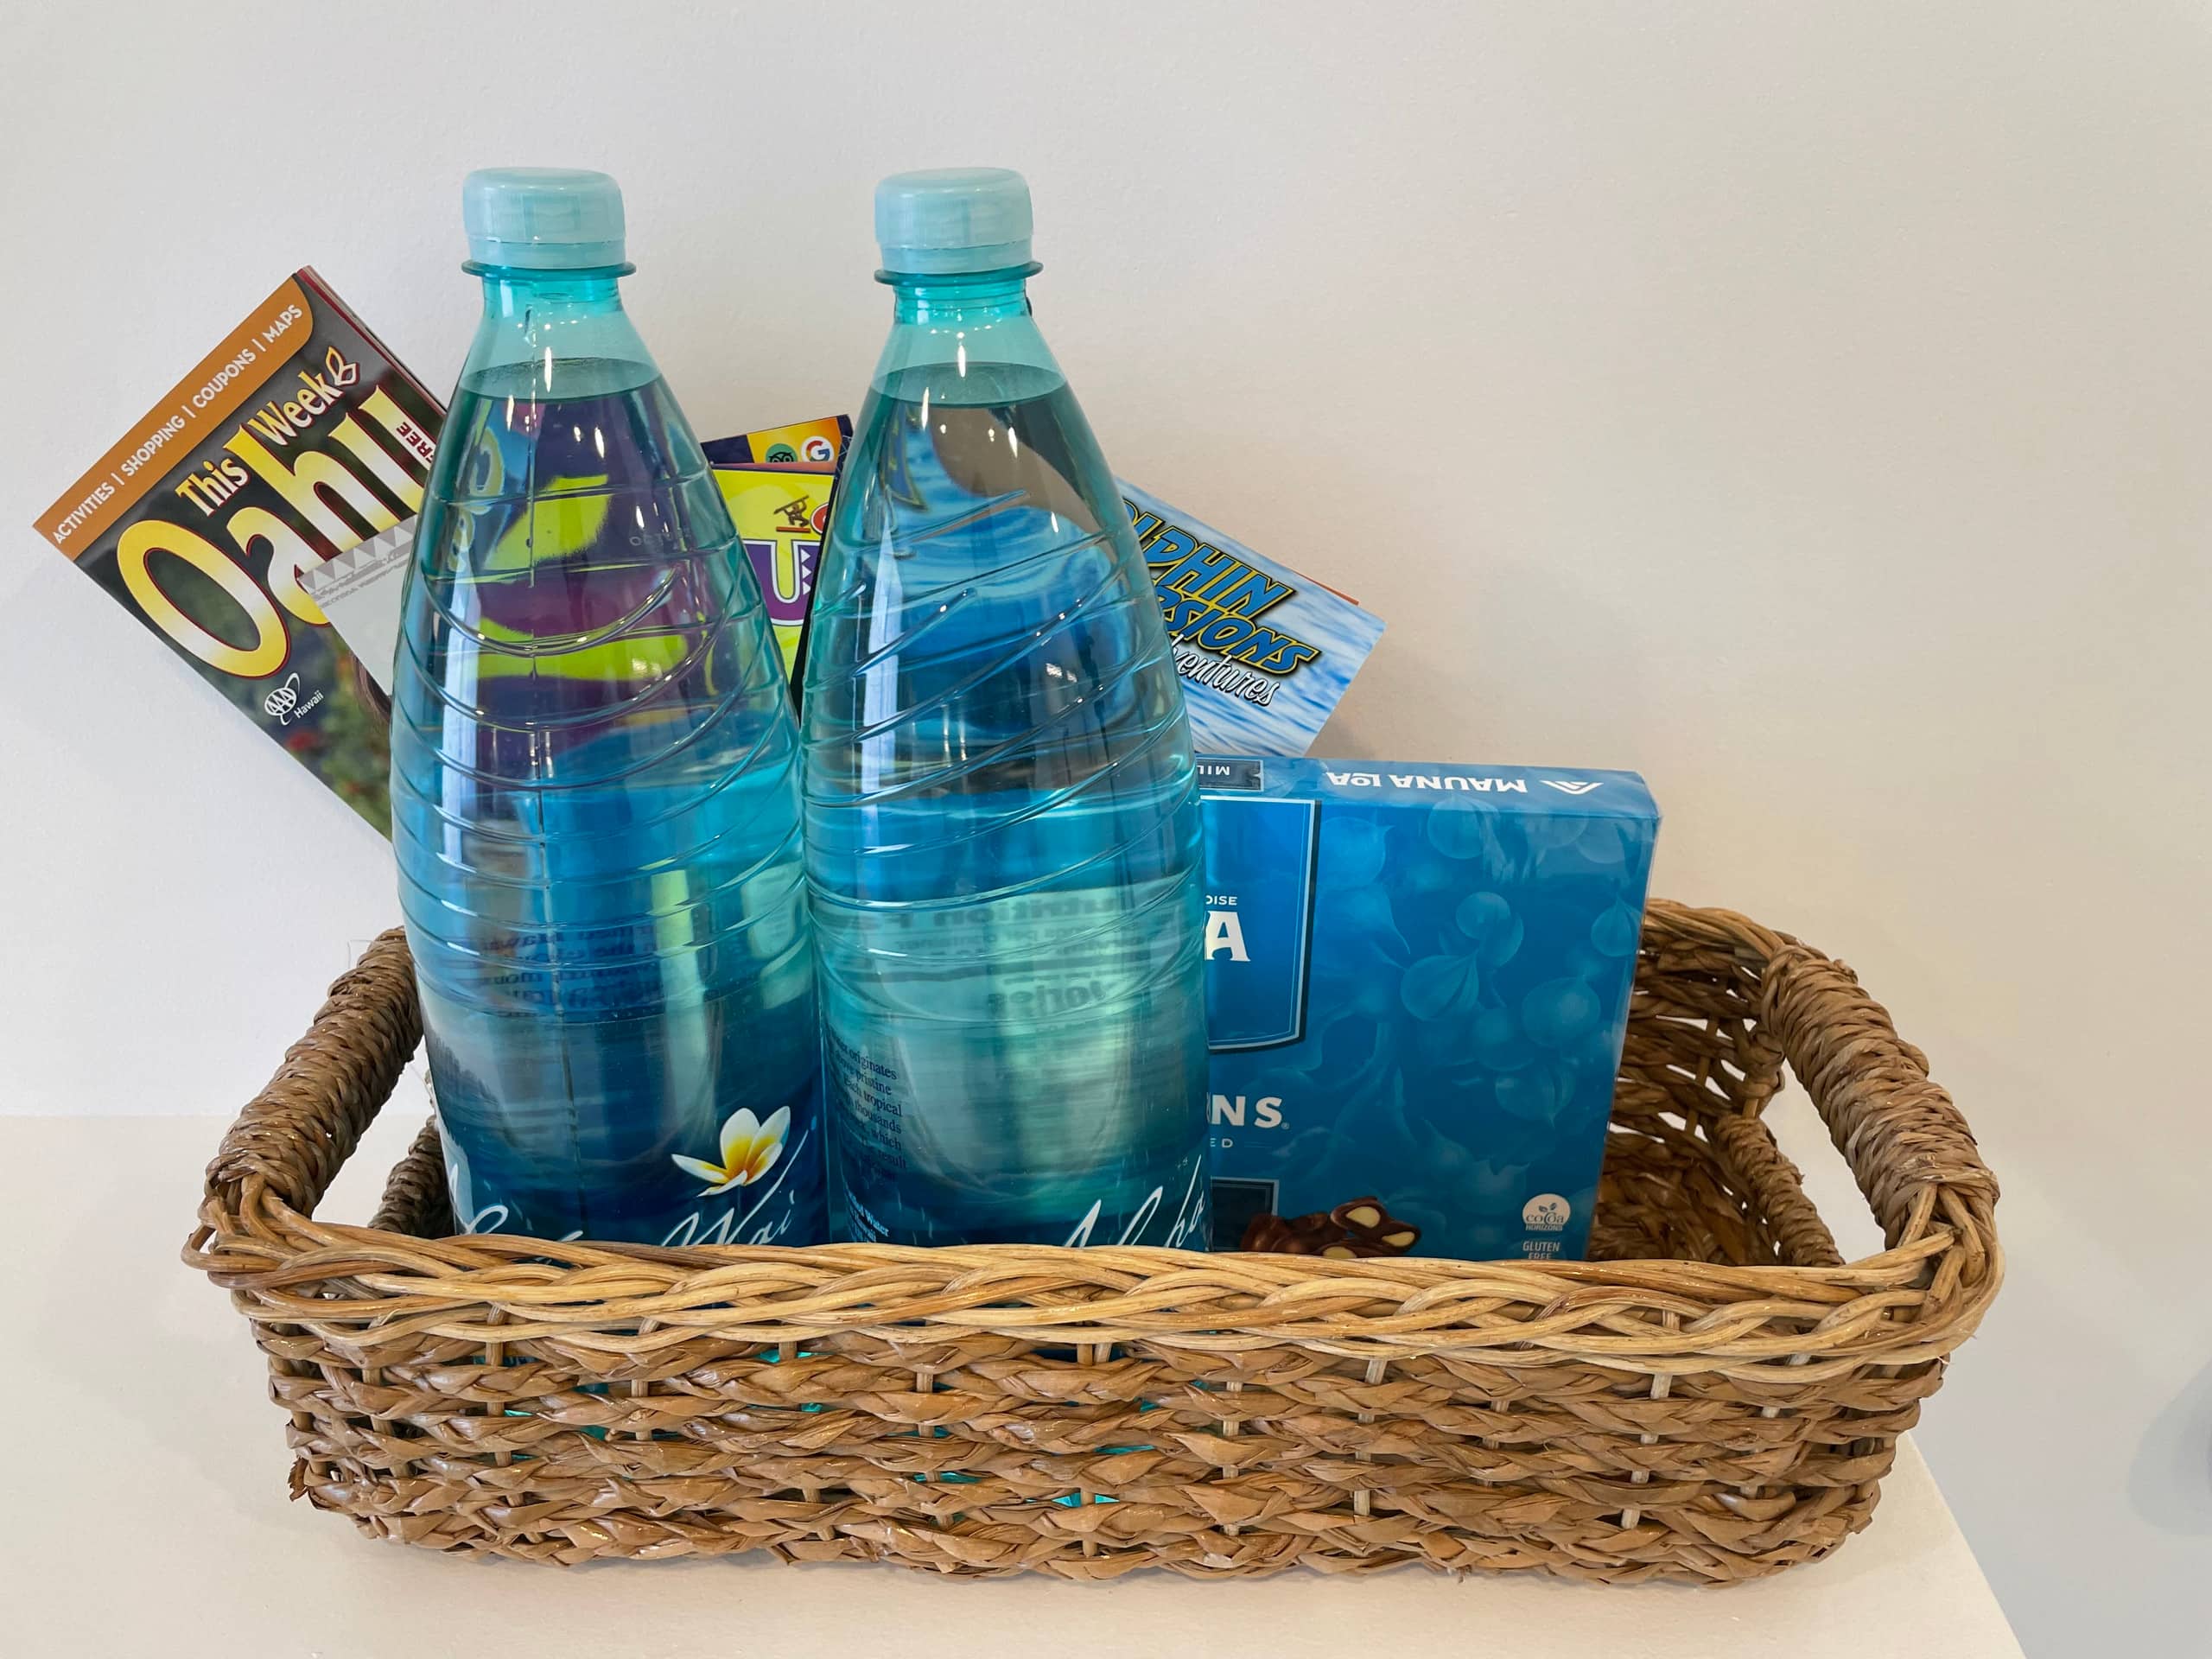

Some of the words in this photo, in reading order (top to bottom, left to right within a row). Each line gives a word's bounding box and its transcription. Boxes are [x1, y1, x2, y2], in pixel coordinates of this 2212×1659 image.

[53, 482, 115, 544] ACTIVITIES
[121, 415, 185, 476] SHOPPING
[193, 348, 256, 408] COUPONS
[262, 304, 302, 343] MAPS
[175, 458, 250, 518] This
[248, 371, 345, 446] Week
[294, 690, 324, 719] Hawaii
[1326, 772, 1382, 787] LOA
[1388, 774, 1529, 792] MAUNA
[849, 1048, 898, 1080] originates
[863, 1090, 902, 1116] tropical
[1522, 1241, 1560, 1252] GLUTEN
